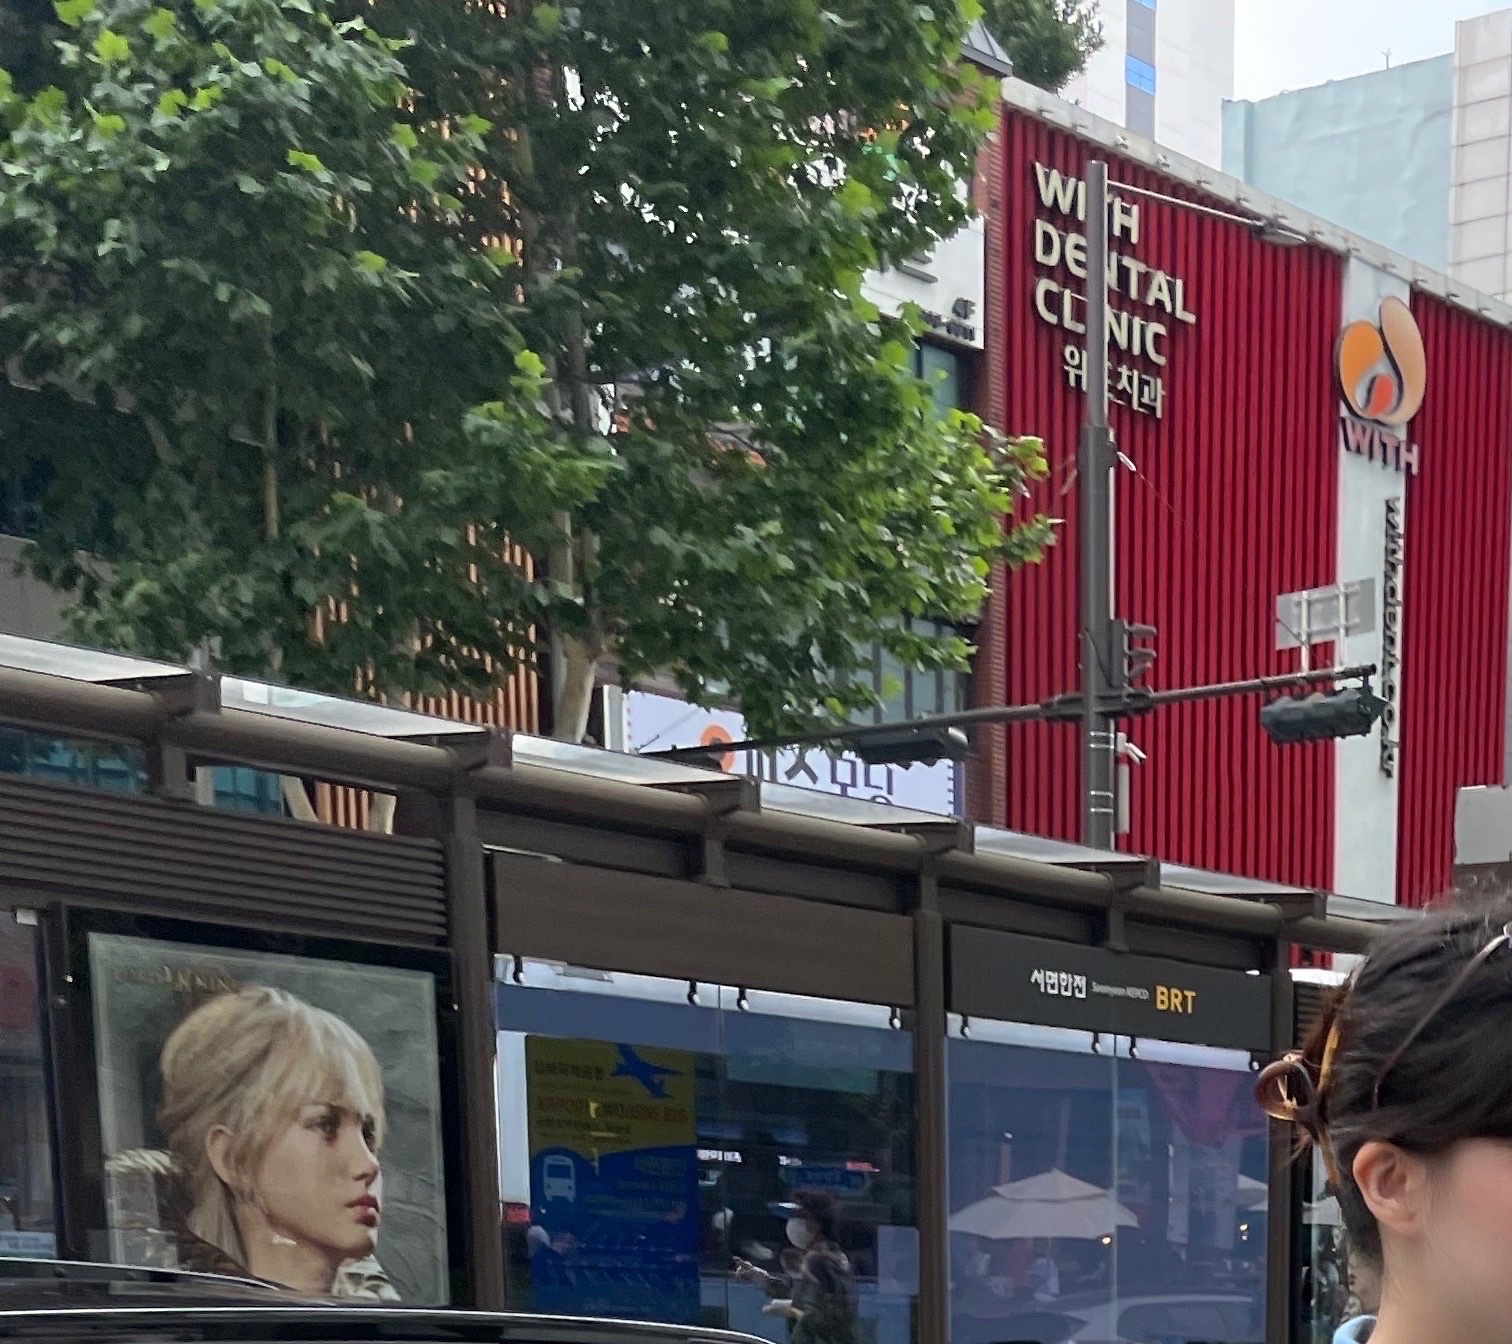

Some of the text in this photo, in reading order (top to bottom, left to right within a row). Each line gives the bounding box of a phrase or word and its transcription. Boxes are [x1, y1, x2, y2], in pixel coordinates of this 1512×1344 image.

[1034, 161, 1139, 245] WIH
[1035, 277, 1166, 367] CLNIC
[1064, 345, 1165, 419] 위치과
[1342, 417, 1419, 476] WITH
[1030, 968, 1087, 999] 서면한전
[1156, 984, 1197, 1014] BRT
